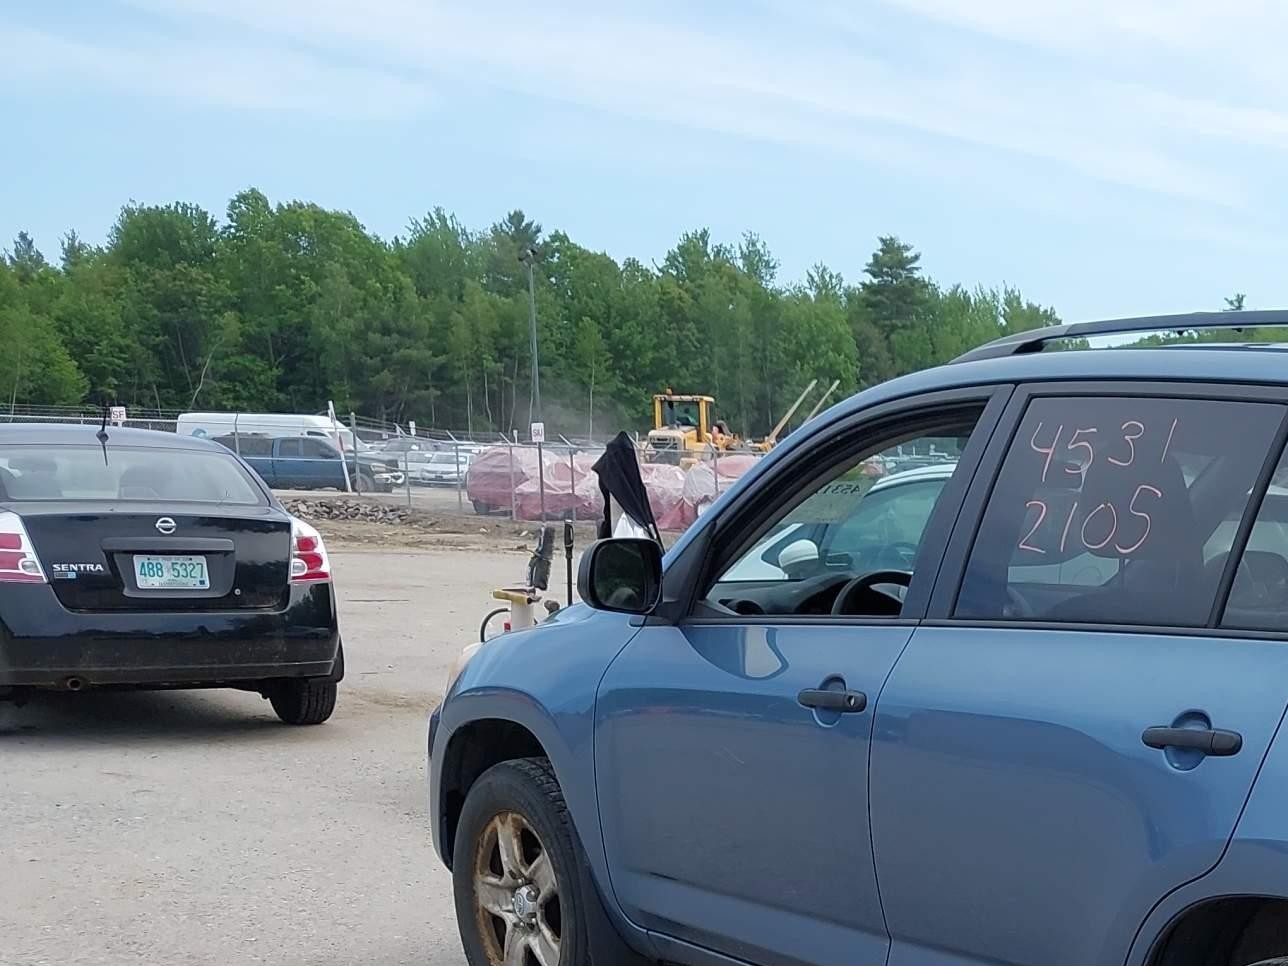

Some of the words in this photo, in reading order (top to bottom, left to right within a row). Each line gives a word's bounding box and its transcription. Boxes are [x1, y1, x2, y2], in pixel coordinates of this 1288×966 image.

[1030, 417, 1178, 482] 4531
[1019, 484, 1162, 554] 2105
[52, 563, 104, 572] SENTRA
[140, 561, 164, 578] 488
[171, 561, 204, 579] 5327
